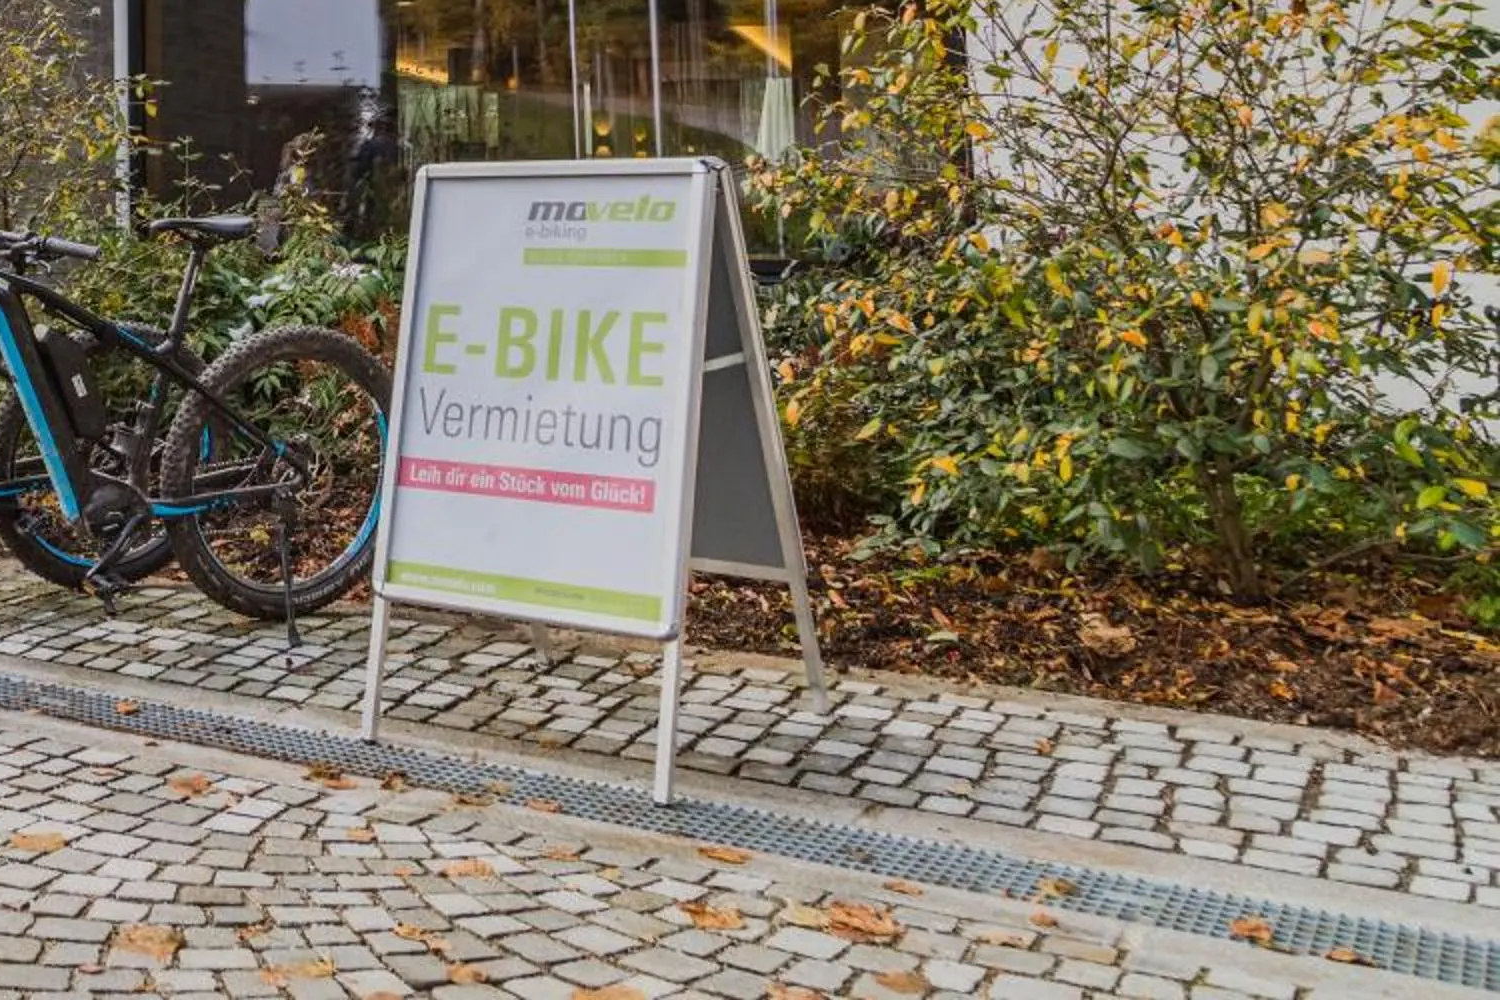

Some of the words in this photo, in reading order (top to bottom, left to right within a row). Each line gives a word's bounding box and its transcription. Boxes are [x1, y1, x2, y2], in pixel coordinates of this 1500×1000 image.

[528, 195, 676, 222] movelo
[525, 224, 588, 241] e-biking
[422, 304, 668, 388] E-BIKE
[420, 386, 663, 468] Vermietung
[409, 464, 442, 485] Leih
[445, 468, 468, 486] dir
[470, 470, 495, 489] ein
[499, 471, 546, 494] Stück
[551, 482, 585, 498] vom
[590, 480, 646, 505] Glück!
